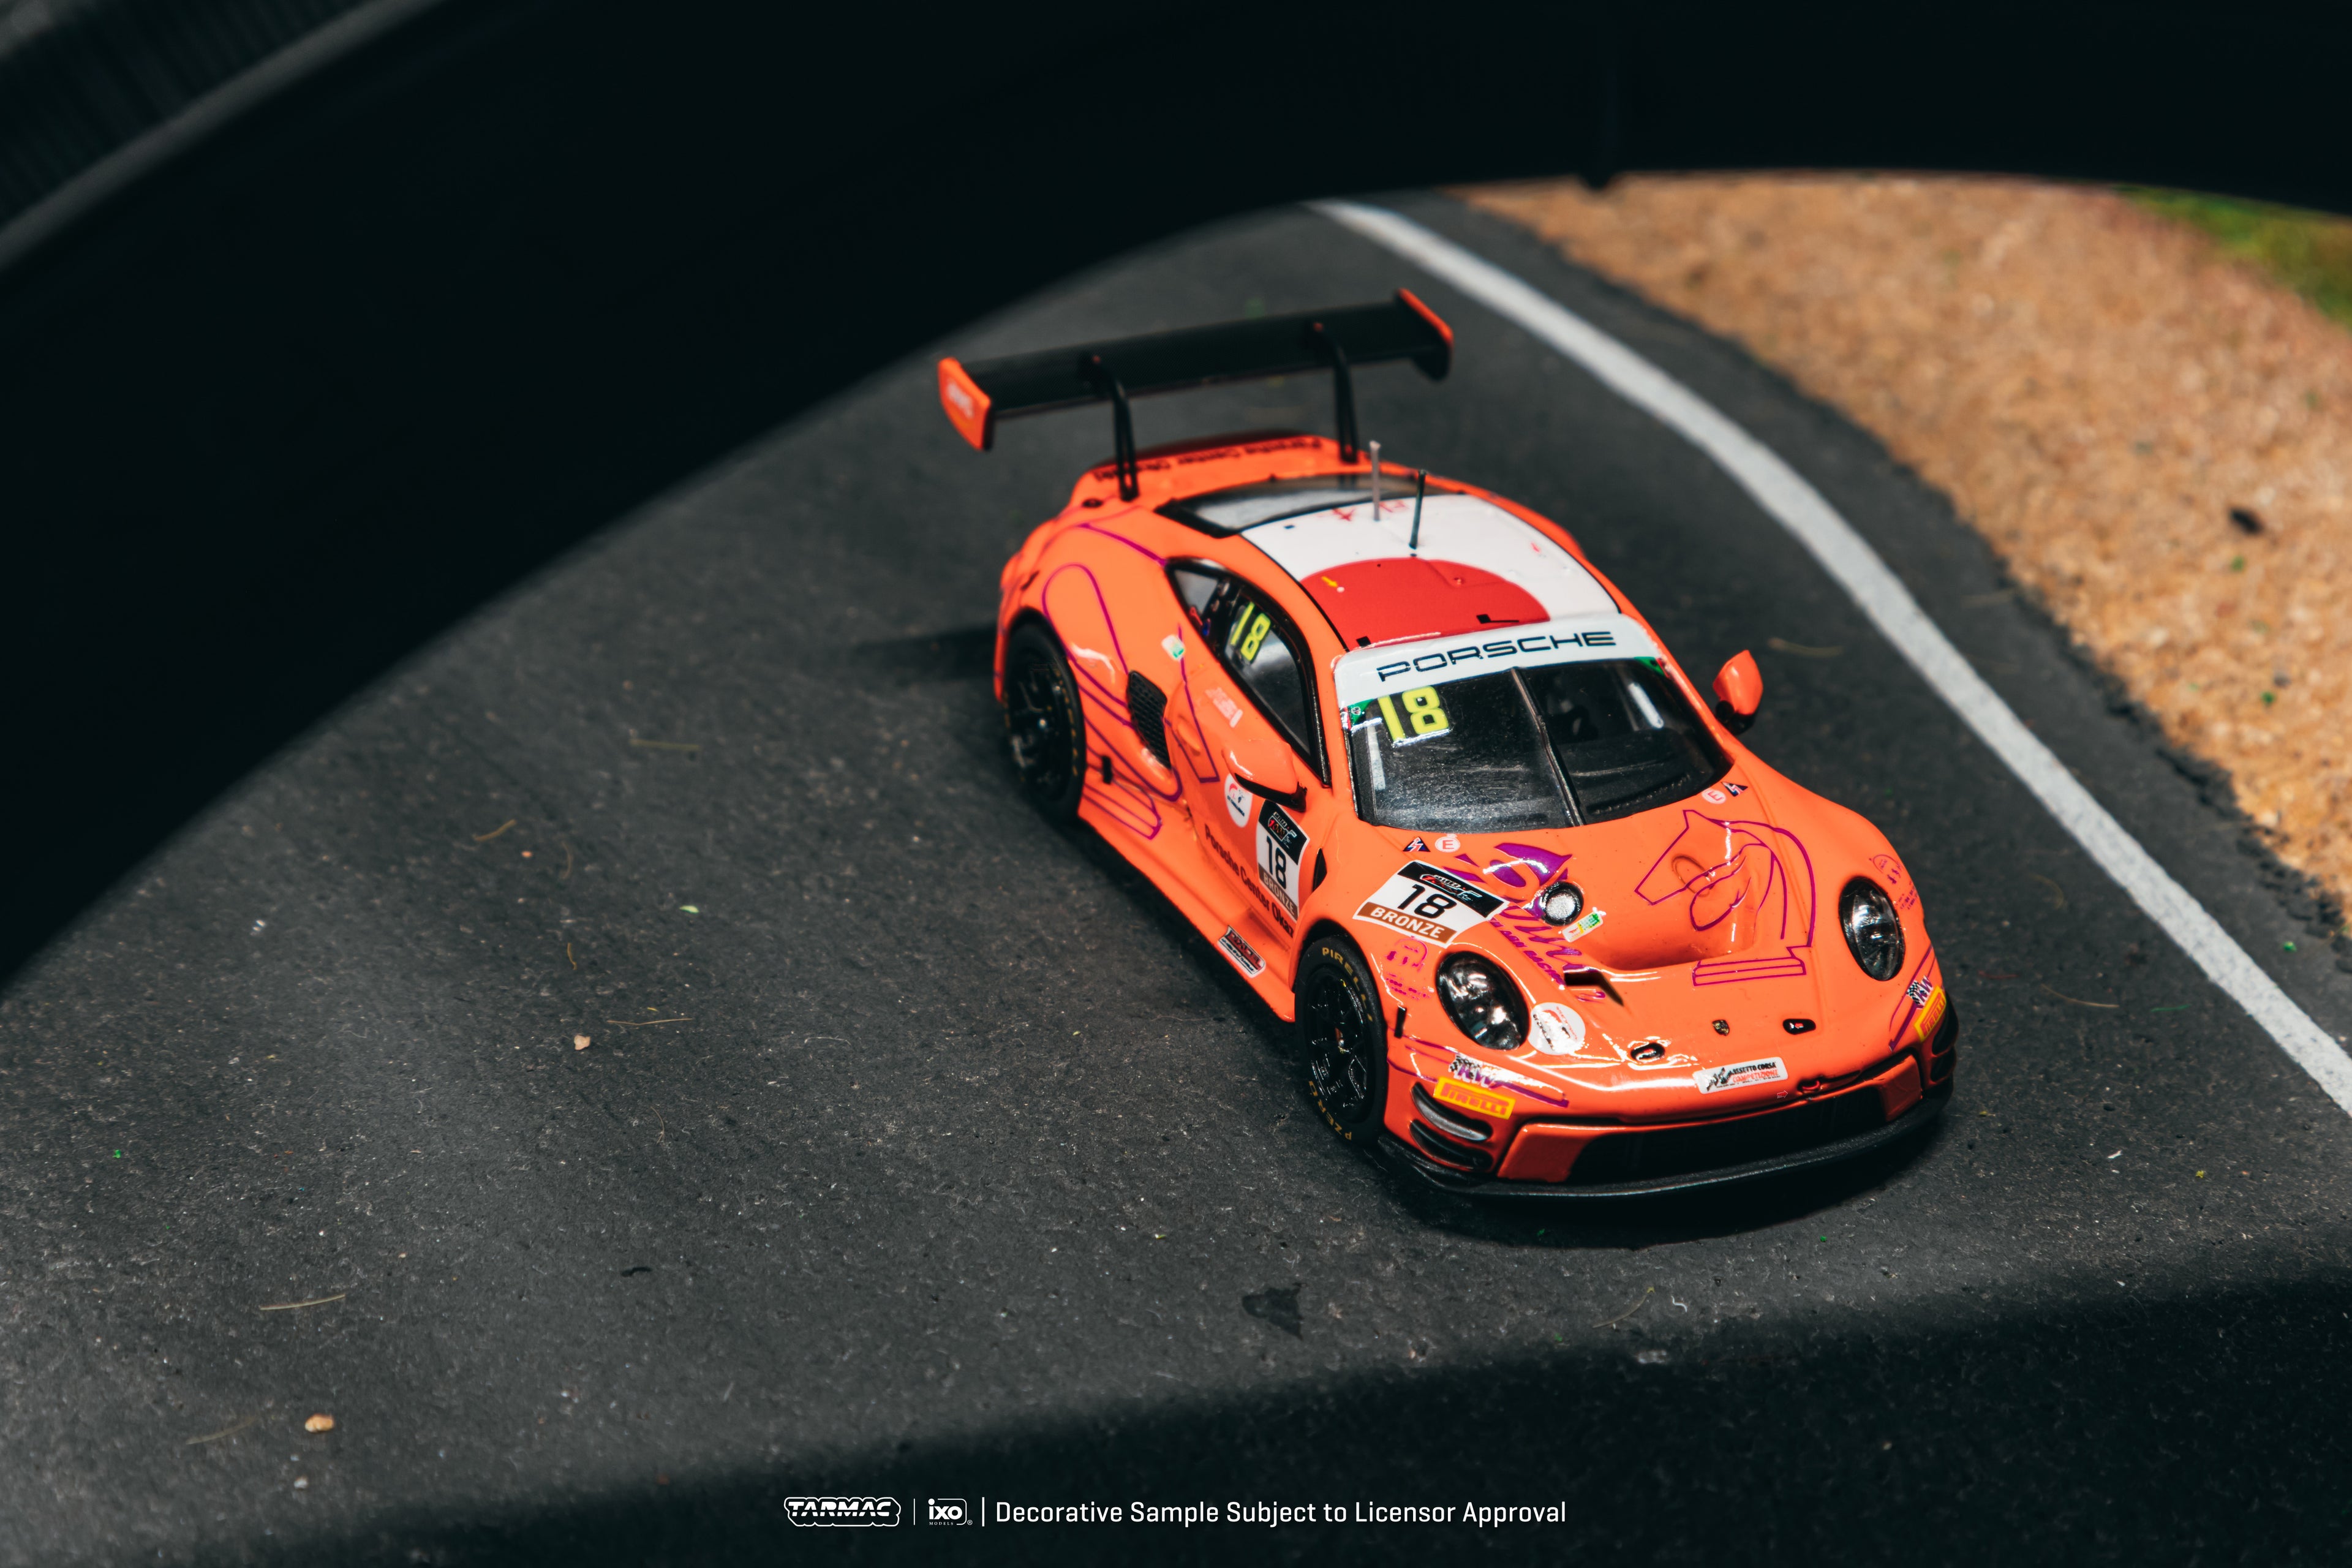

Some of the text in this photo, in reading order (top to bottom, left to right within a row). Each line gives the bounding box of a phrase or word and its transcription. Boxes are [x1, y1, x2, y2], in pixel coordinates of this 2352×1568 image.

[1230, 601, 1271, 662] 18
[1376, 630, 1617, 682] PORSCHE
[1378, 684, 1450, 743] 18
[1204, 823, 1240, 876] Porsche
[1240, 870, 1272, 911] Center
[1266, 835, 1288, 890] 18
[1263, 873, 1295, 916] BRONZE
[1398, 884, 1457, 919] 18
[1370, 907, 1446, 939] BRONZE
[1322, 946, 1374, 1023] PIRELLI
[1920, 992, 1946, 1037] PIRELLI
[1757, 1061, 1776, 1071] CORSA
[1439, 1082, 1510, 1116] PIRELLI
